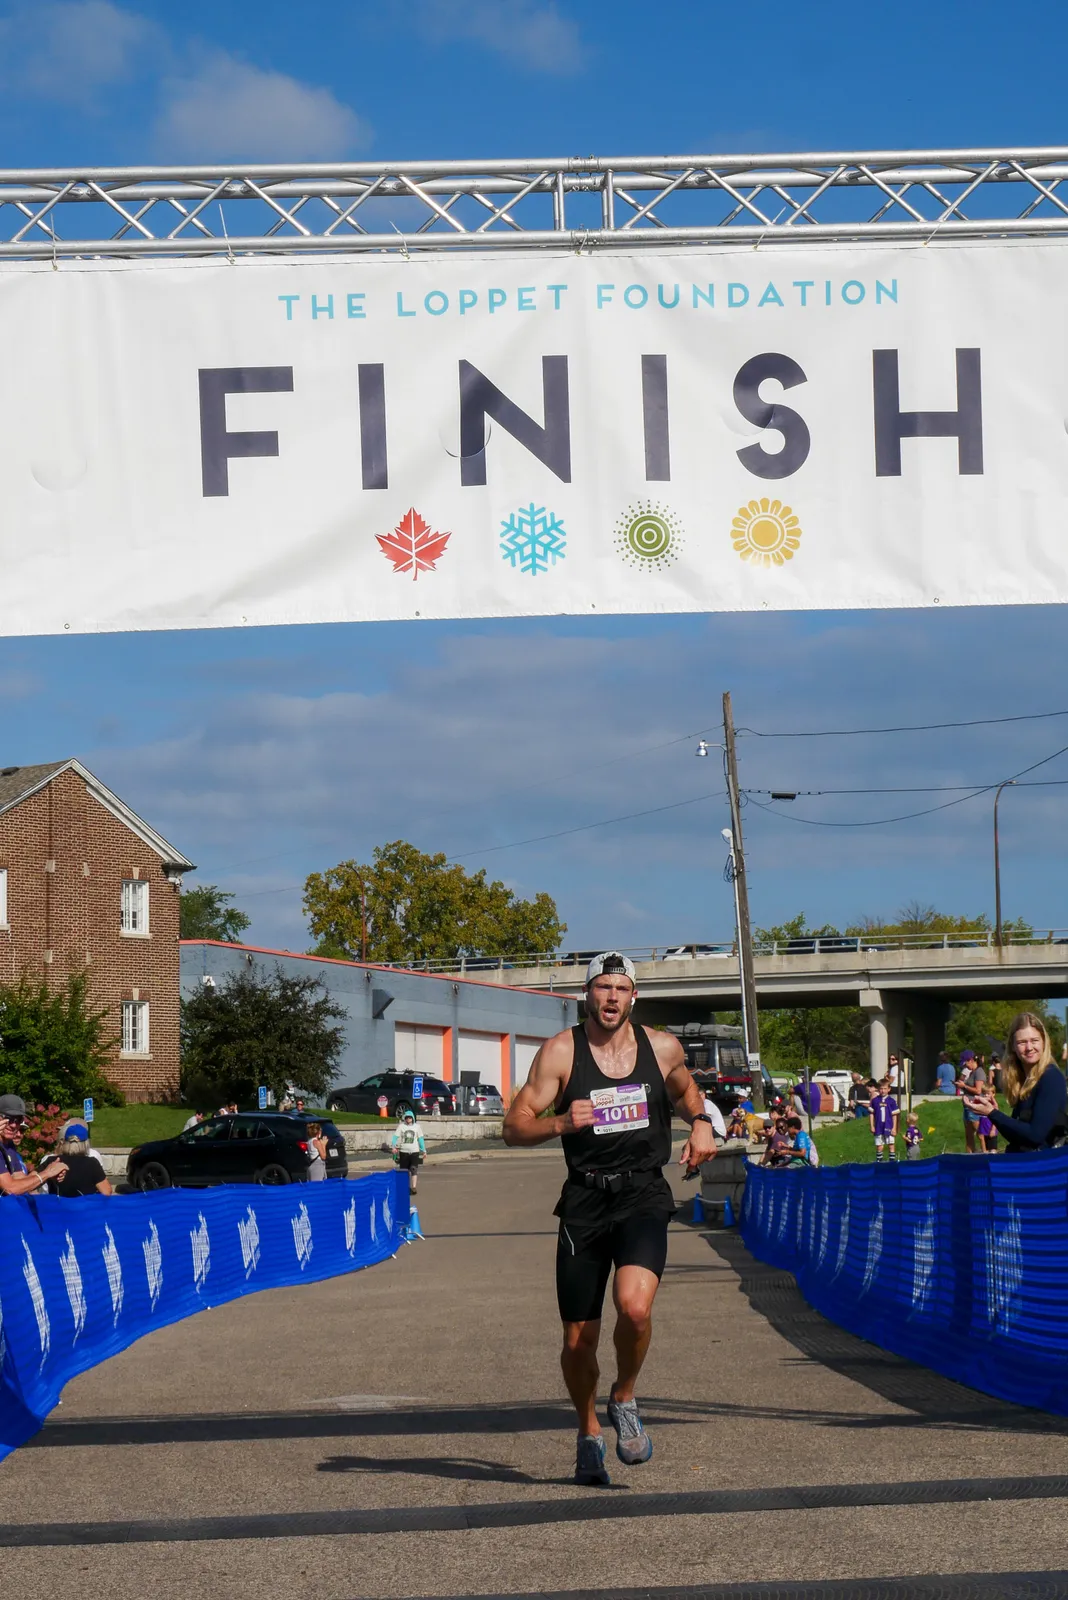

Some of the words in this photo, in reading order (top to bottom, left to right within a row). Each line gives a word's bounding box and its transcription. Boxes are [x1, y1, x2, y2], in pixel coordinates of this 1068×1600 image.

[278, 293, 366, 320] THE
[397, 284, 569, 317] LOPPET
[597, 279, 899, 309] FOUNDATION
[198, 348, 984, 498] FINISH
[602, 1105, 638, 1122] 1011
[880, 1107, 886, 1122] 1
